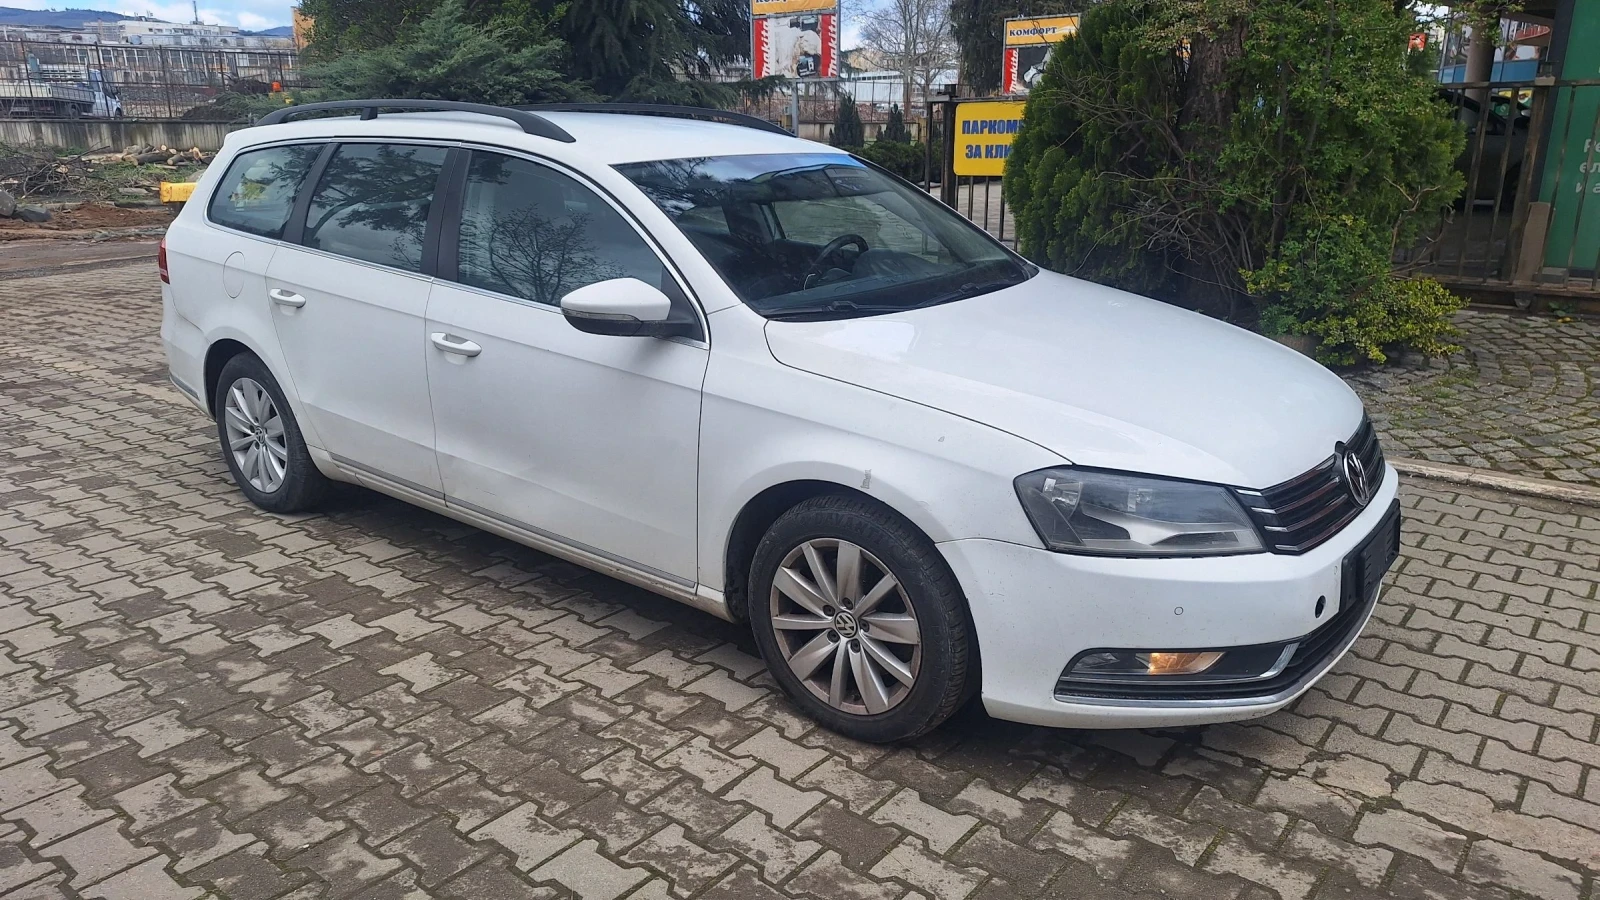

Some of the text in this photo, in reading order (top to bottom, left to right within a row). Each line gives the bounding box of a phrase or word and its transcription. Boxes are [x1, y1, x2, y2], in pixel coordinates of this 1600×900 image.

[761, 20, 770, 77] makita
[828, 15, 838, 77] makita
[1009, 27, 1057, 37] КОМФОРТ
[1009, 48, 1018, 94] makita
[965, 144, 983, 159] ЗА
